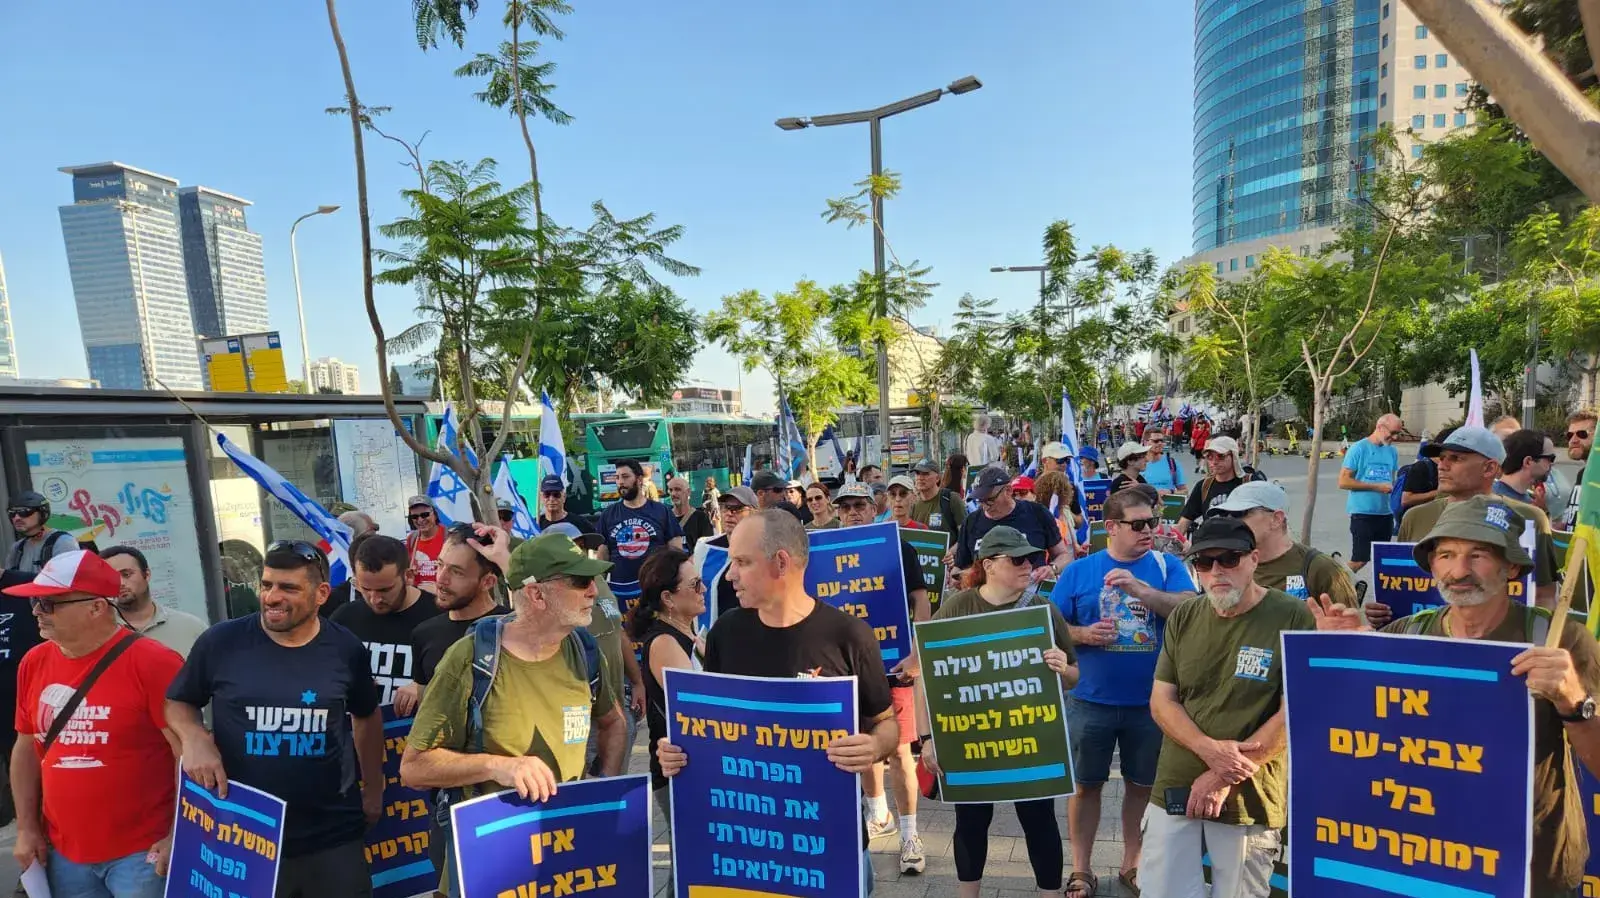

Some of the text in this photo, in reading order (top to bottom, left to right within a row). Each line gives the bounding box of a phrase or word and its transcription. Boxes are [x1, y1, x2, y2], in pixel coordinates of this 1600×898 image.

[610, 518, 657, 538] NEW YORK CITY
[835, 554, 860, 571] אין
[917, 555, 940, 567] ביט
[817, 576, 885, 597] צבא-עם
[1378, 573, 1437, 592] ישראל
[362, 641, 413, 677] רמ
[933, 647, 1043, 677] ביטול עילת
[958, 677, 1042, 703] הסבירות
[1375, 685, 1429, 718] אין
[245, 706, 329, 733] חופשי
[675, 712, 747, 741] ישראל
[936, 704, 1057, 733] עילה לביטול
[58, 731, 110, 746] דמוקר
[245, 731, 325, 756] בארצנו
[964, 737, 1038, 759] השירות
[1329, 728, 1483, 773] צבא-עם
[721, 755, 802, 784] הפרתם
[388, 799, 428, 820] בלי
[710, 788, 820, 821] את החוזה
[1371, 778, 1436, 816] בלי
[181, 797, 276, 861] ממשלת ישראל
[708, 822, 825, 855] עם משרתי
[530, 828, 575, 865] אין
[1315, 815, 1500, 875] דמוקרטיה
[200, 843, 247, 881] הפרתם
[712, 853, 825, 889] המילואים!
